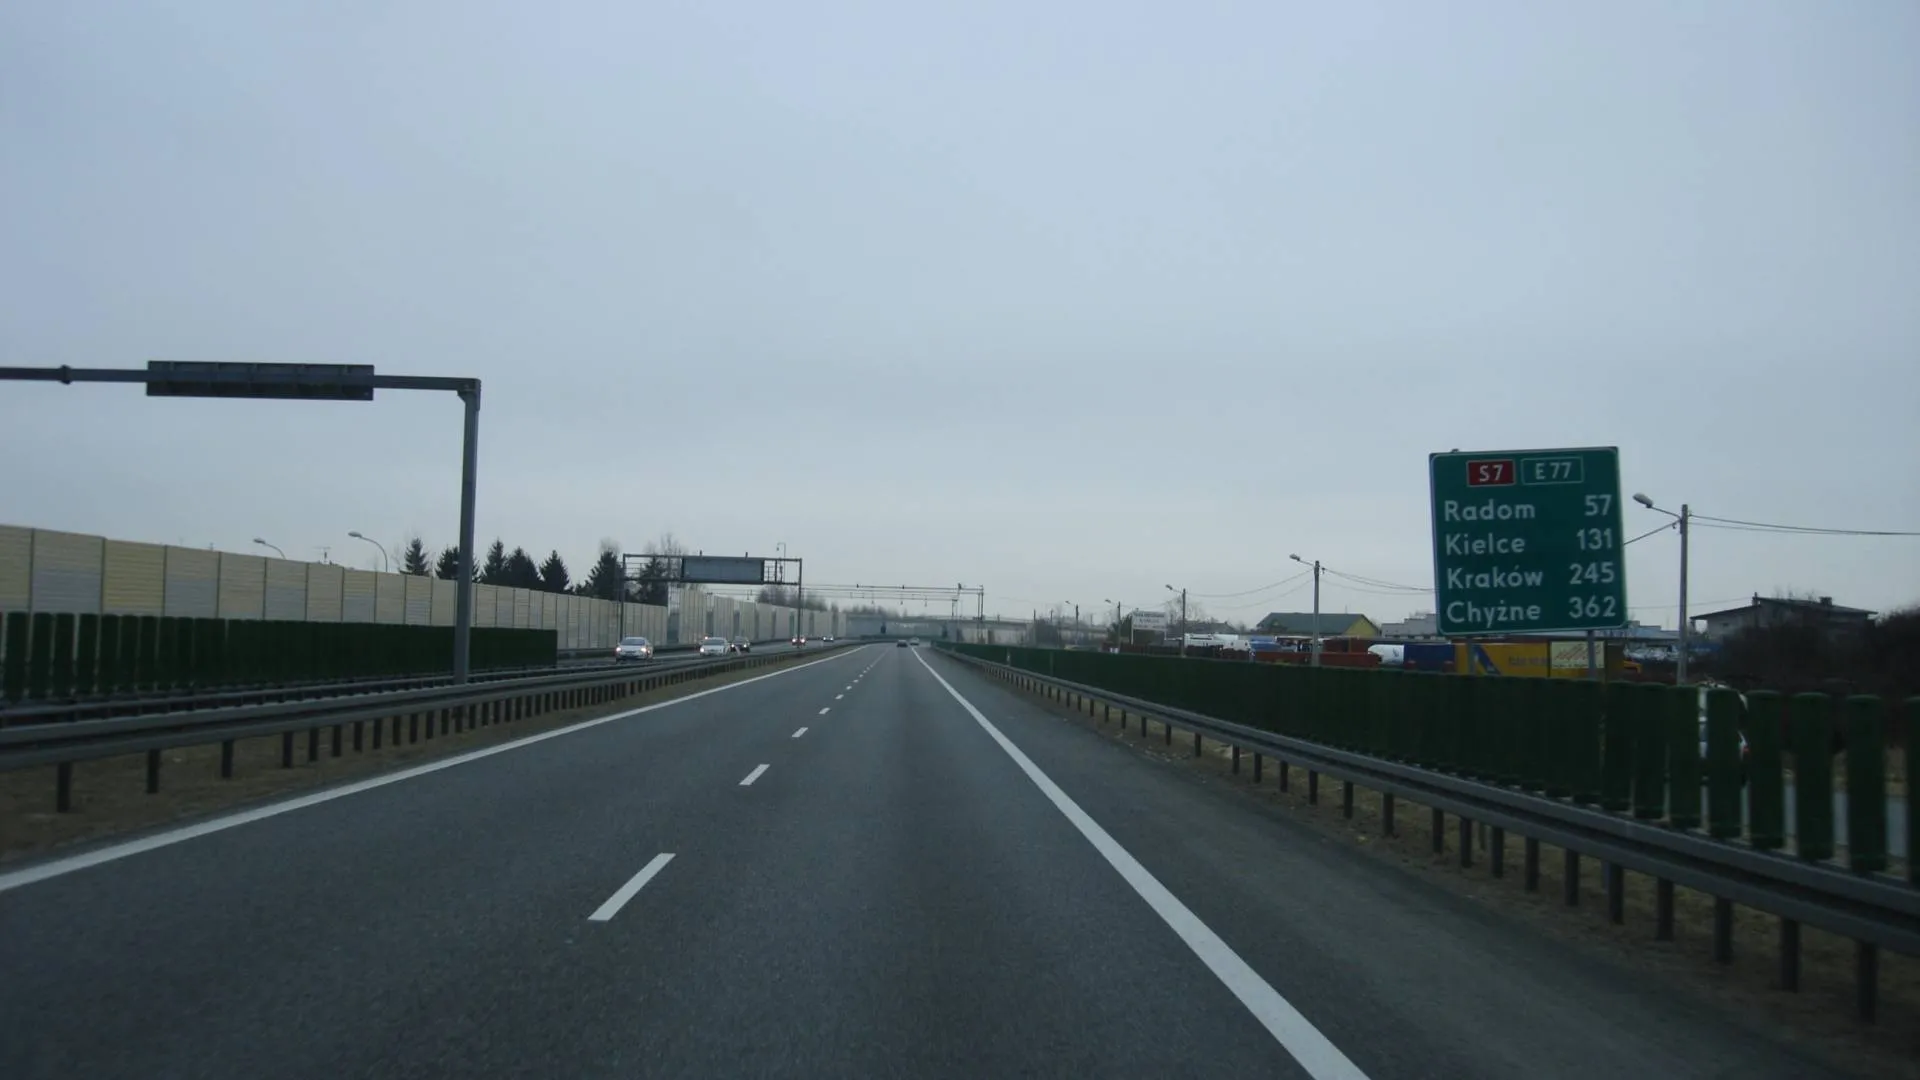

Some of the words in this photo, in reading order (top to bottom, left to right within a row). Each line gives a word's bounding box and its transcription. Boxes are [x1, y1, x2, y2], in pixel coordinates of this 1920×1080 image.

[1444, 498, 1536, 522] Radom
[1584, 494, 1613, 517] 57
[1445, 533, 1526, 556] Kielce
[1576, 527, 1613, 551] 131
[1447, 564, 1544, 589] Kraków
[1568, 561, 1616, 585] 245
[1446, 600, 1542, 628] Chyżne
[1568, 596, 1617, 620] 362
